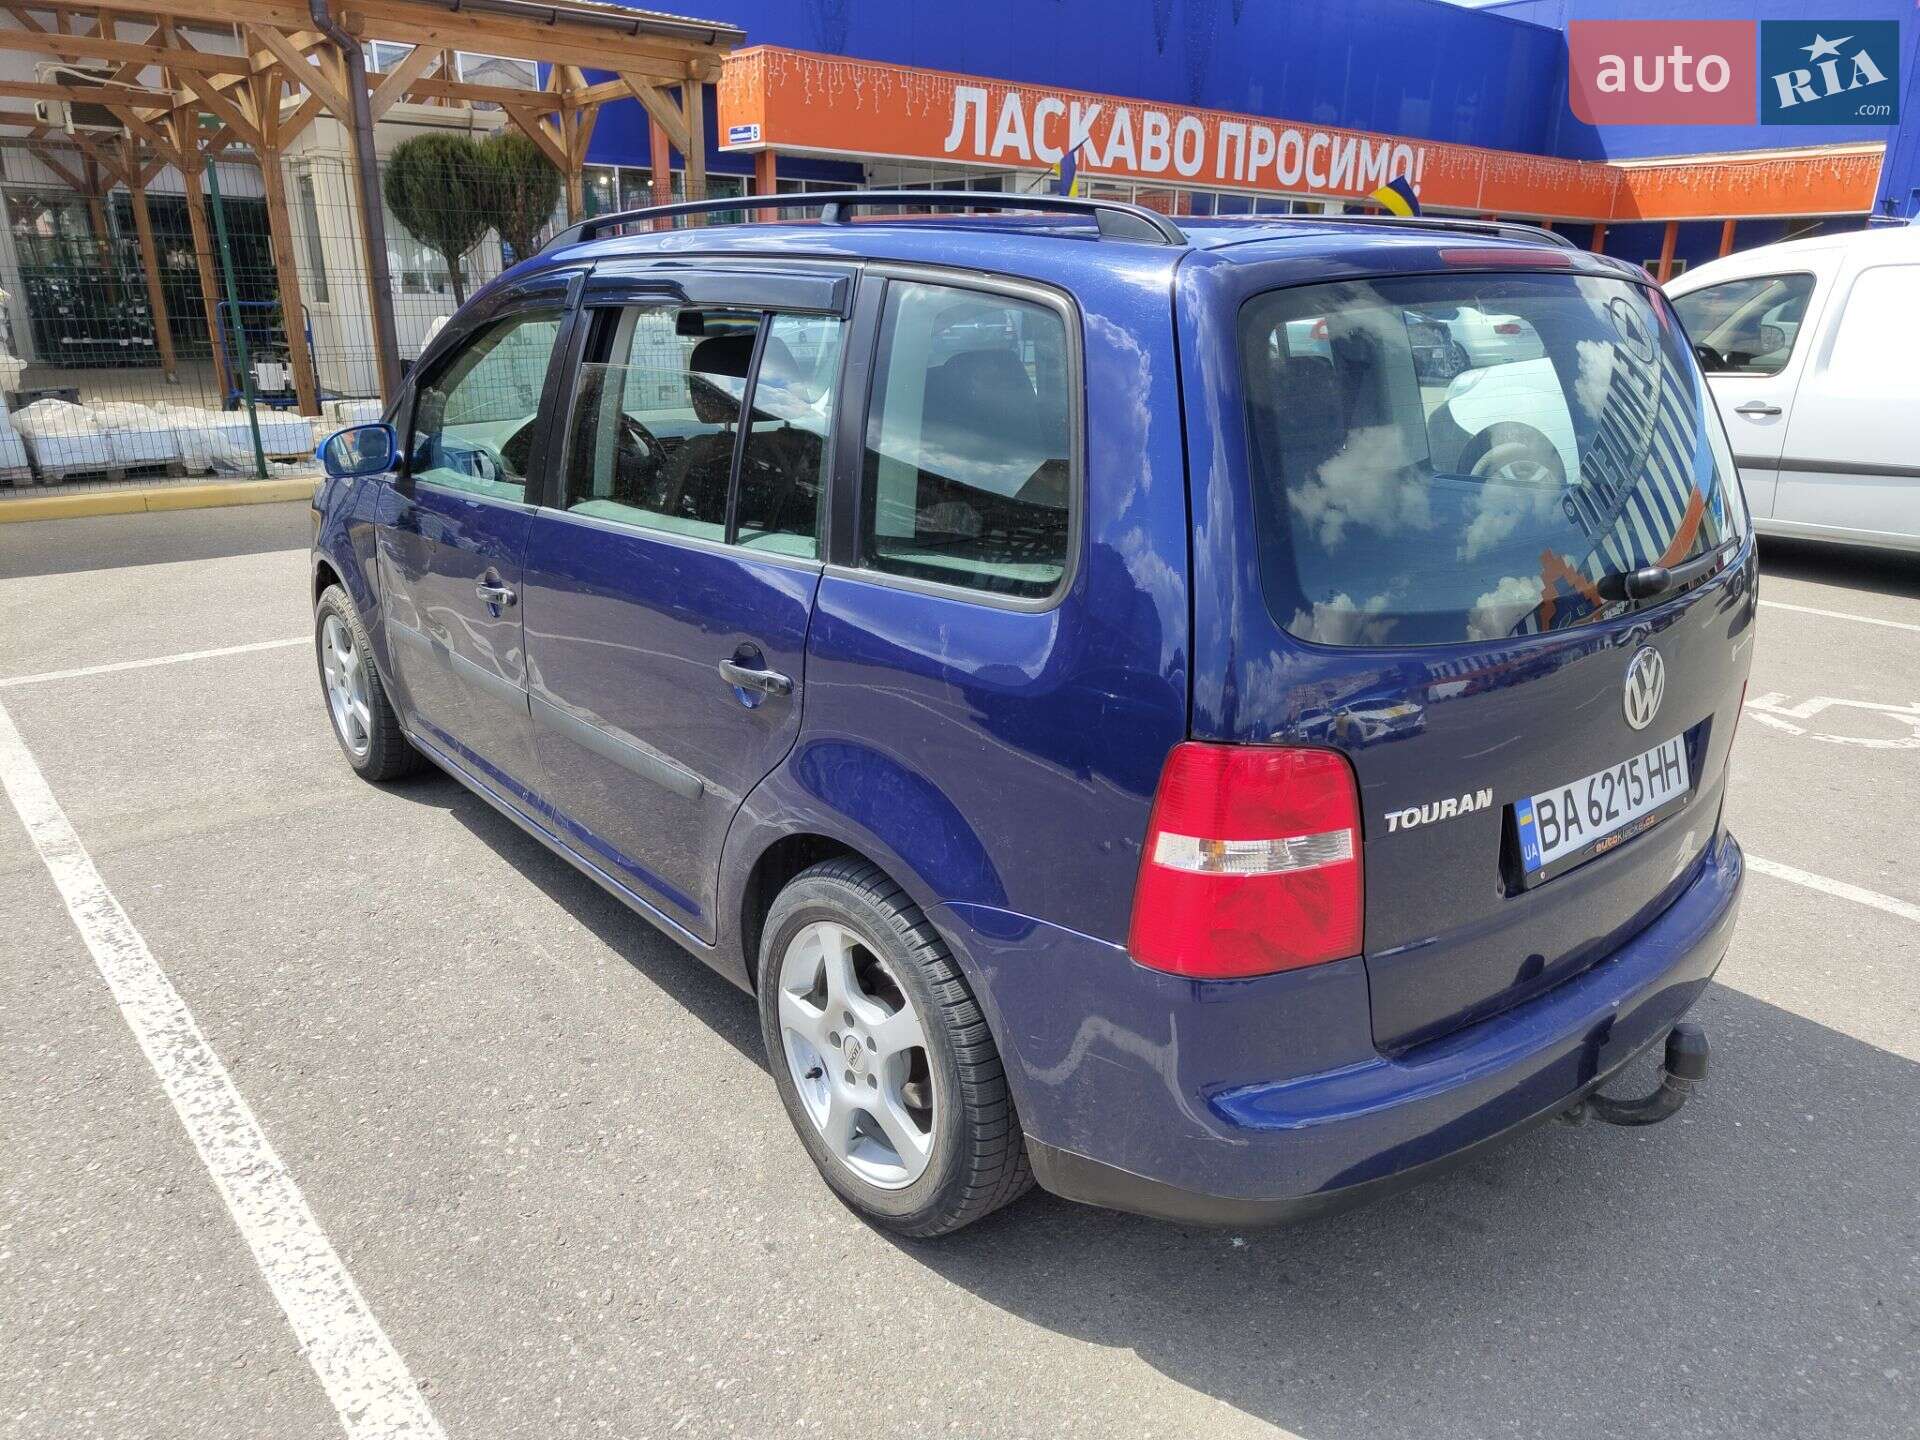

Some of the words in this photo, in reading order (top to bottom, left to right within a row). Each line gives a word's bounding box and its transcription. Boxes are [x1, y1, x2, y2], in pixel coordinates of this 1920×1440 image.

[944, 86, 1205, 176] ЛАСКАВО
[1216, 121, 1425, 195] ПРОСИМО!
[1384, 788, 1493, 832] TOURAN
[1524, 844, 1539, 861] UA
